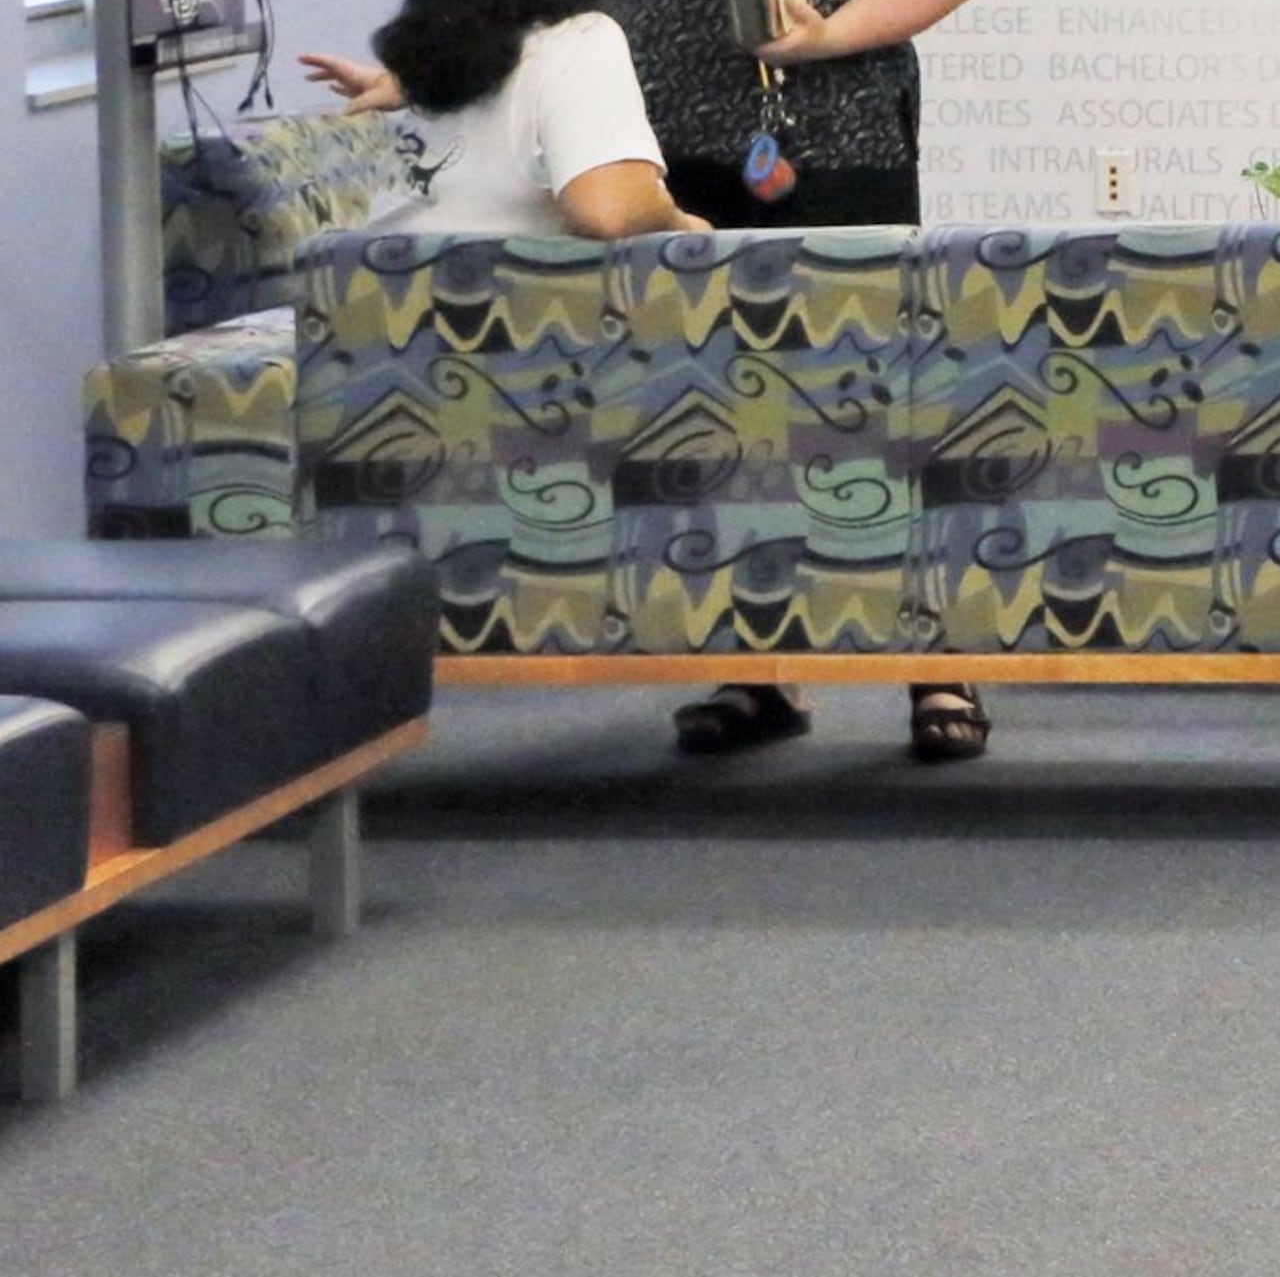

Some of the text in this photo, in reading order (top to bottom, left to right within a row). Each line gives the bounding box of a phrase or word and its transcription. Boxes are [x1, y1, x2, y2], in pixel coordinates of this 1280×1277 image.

[1058, 7, 1241, 36] ENHANCED
[1049, 53, 1247, 83] BACHELOR'S
[1057, 100, 1259, 129] ASSOCIATE'S
[966, 193, 1071, 223] TEAMS
